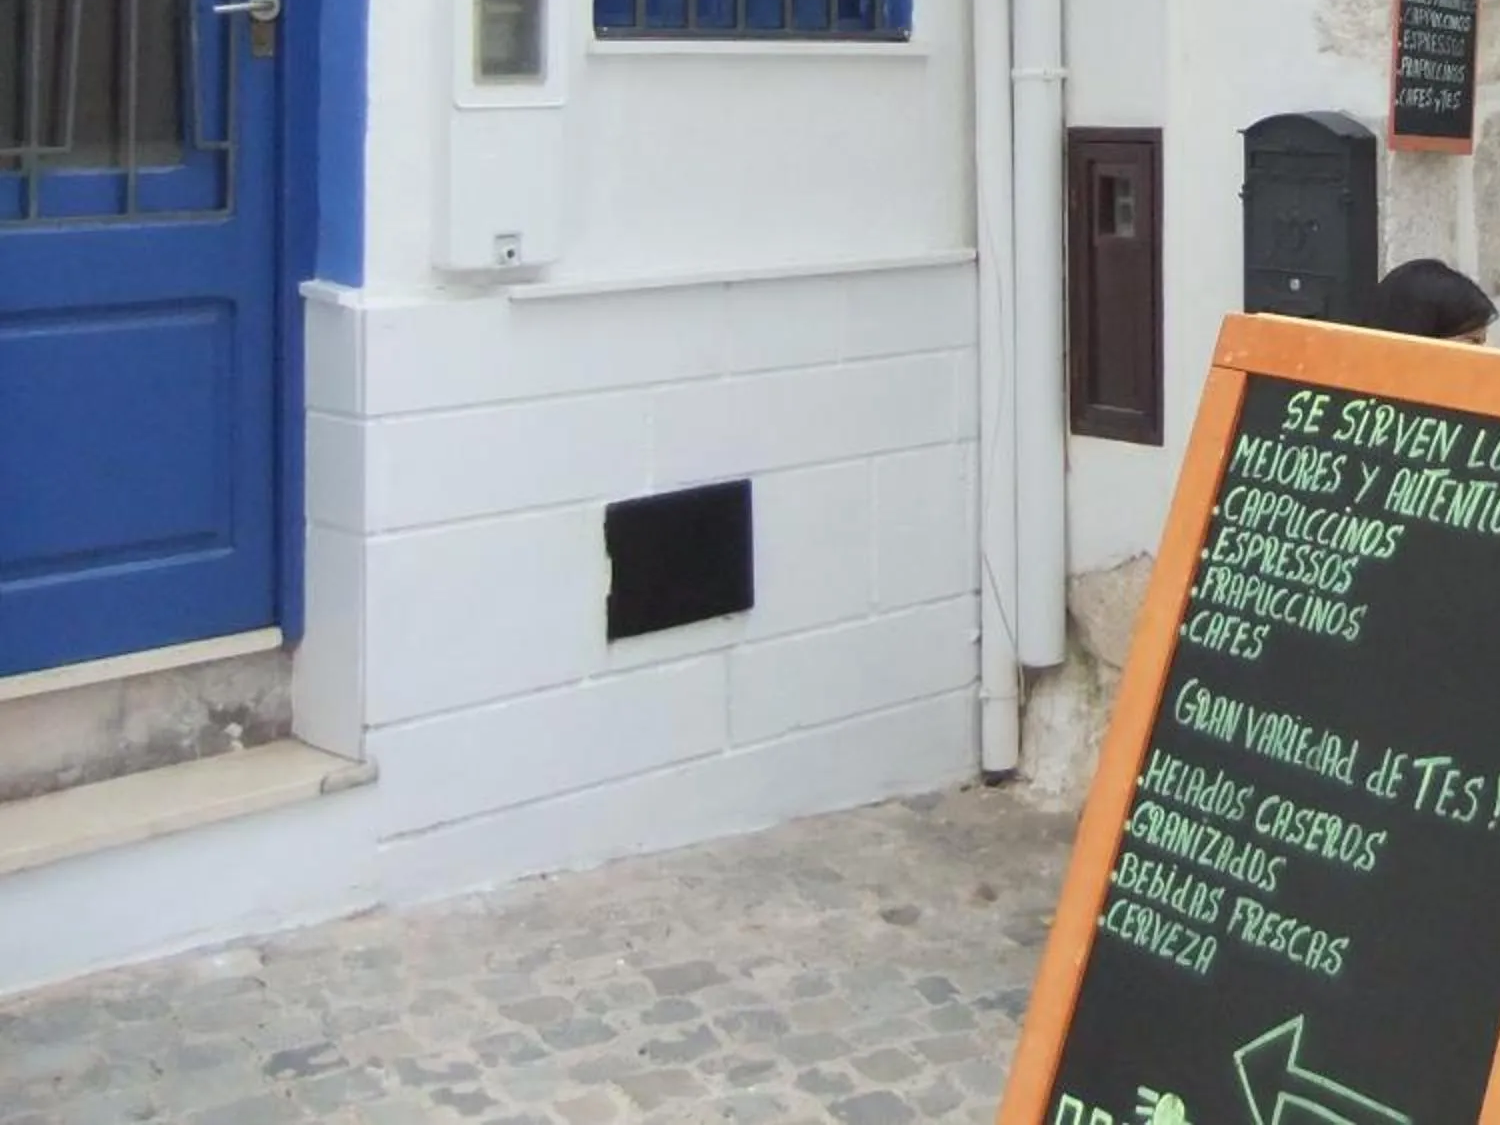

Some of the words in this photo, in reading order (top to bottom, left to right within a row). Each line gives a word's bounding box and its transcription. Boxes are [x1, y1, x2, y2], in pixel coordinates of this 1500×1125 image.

[1282, 390, 1330, 434] SE
[1355, 462, 1380, 503] Y
[1174, 677, 1244, 743] GRAN
[1256, 795, 1388, 872] CASEROS
[1227, 896, 1350, 975] FRESCAS
